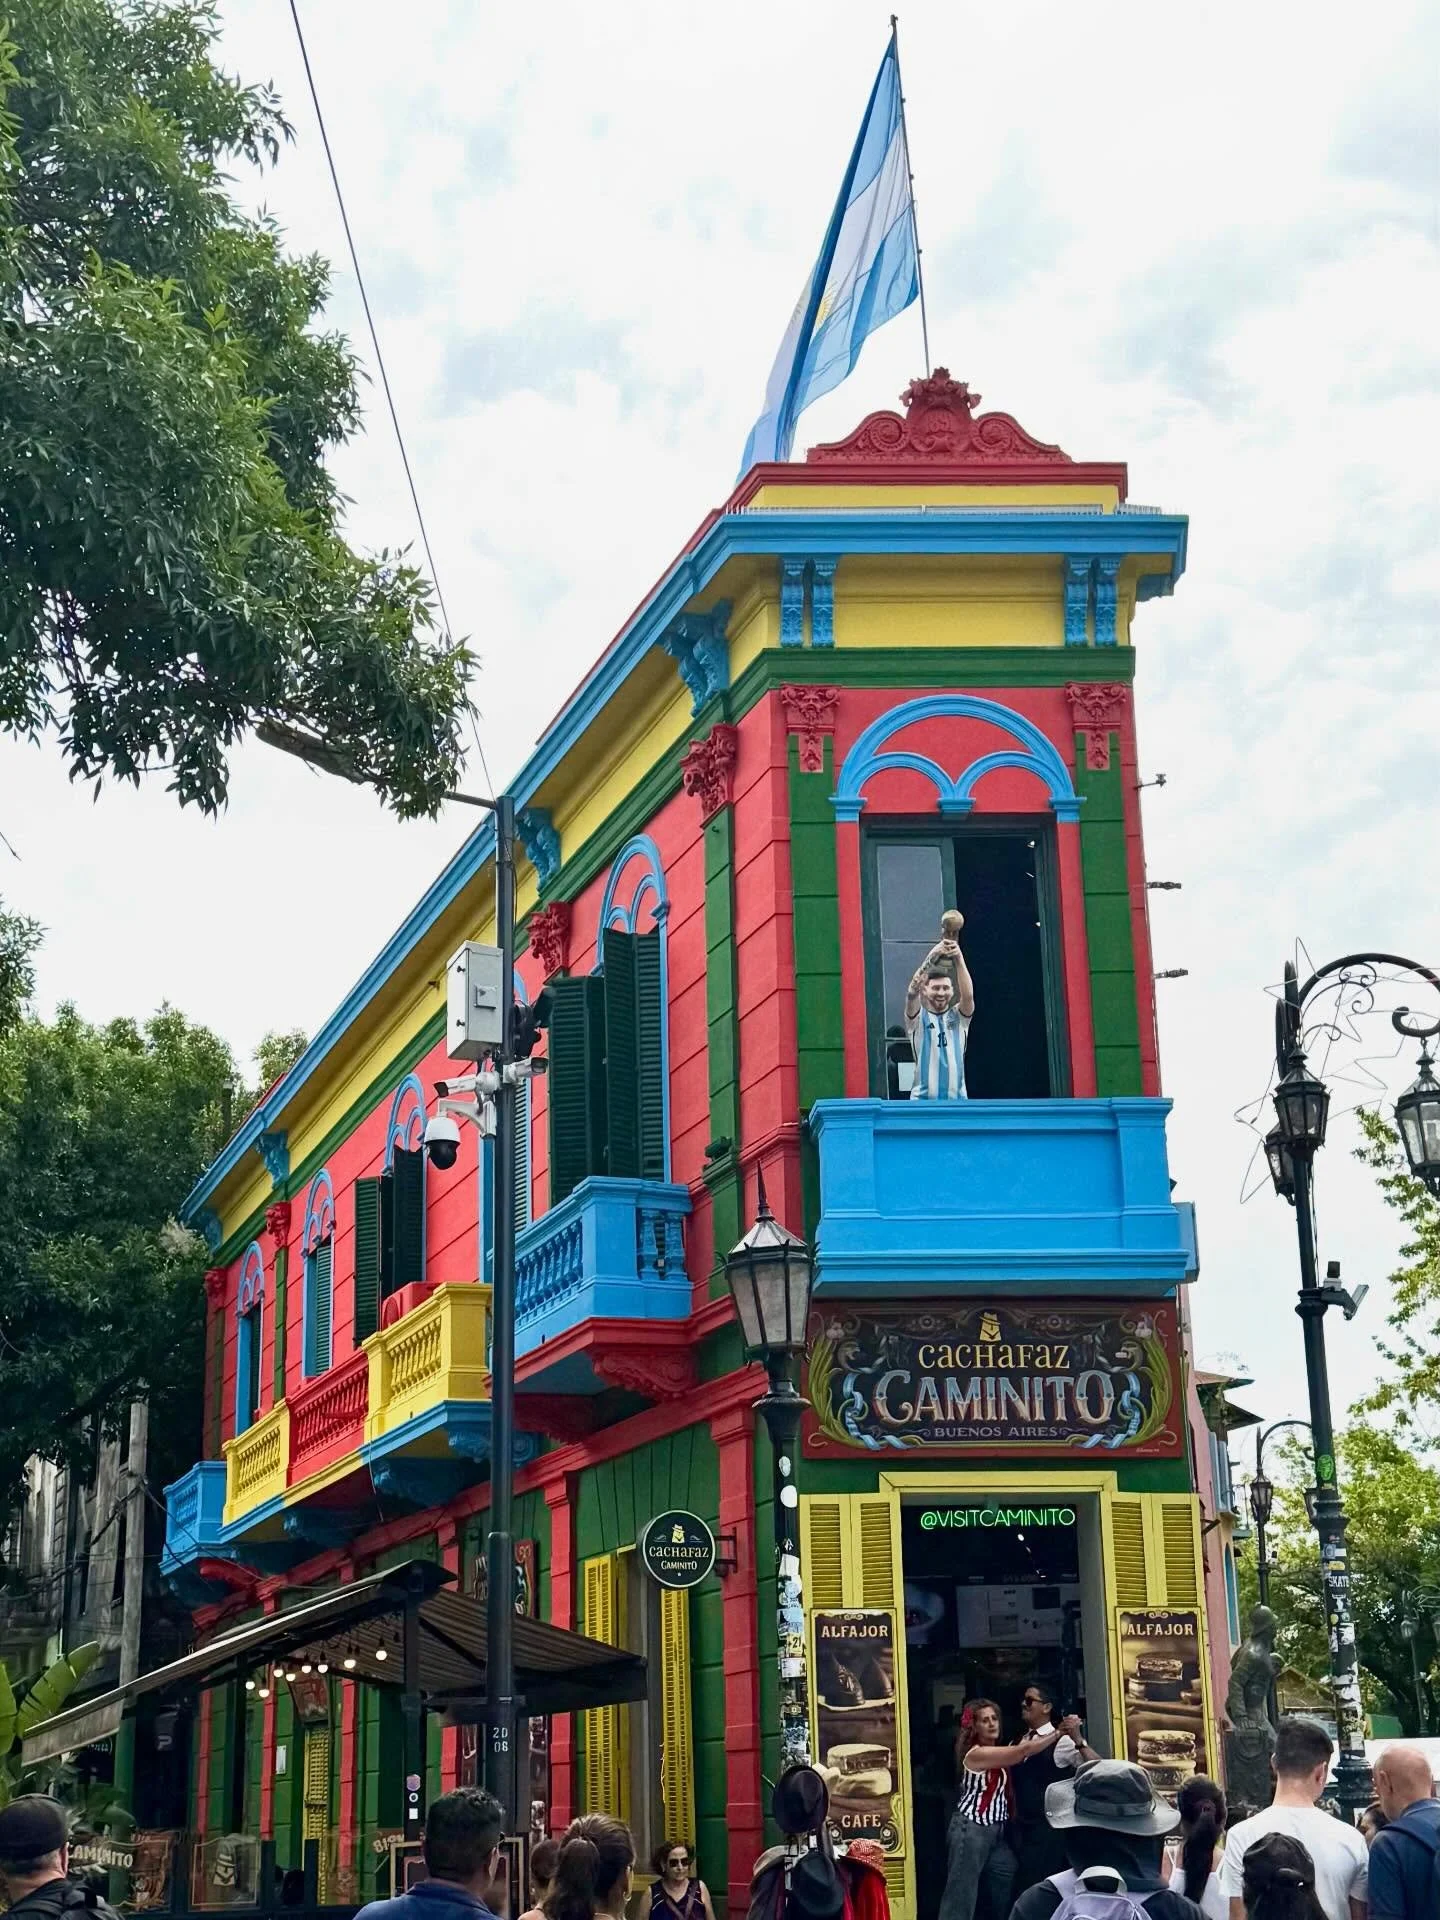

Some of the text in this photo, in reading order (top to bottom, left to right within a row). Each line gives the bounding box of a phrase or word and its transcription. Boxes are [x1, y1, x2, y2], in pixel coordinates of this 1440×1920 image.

[874, 1369, 1115, 1425] CAMINITO
[934, 1426, 1059, 1438] BUENOS AIRES
[920, 1508, 1076, 1530] @VISITCAMINITO
[661, 1560, 698, 1570] CAMINITO
[821, 1625, 889, 1638] ALFAJOR
[1127, 1623, 1194, 1636] ALFAJOR
